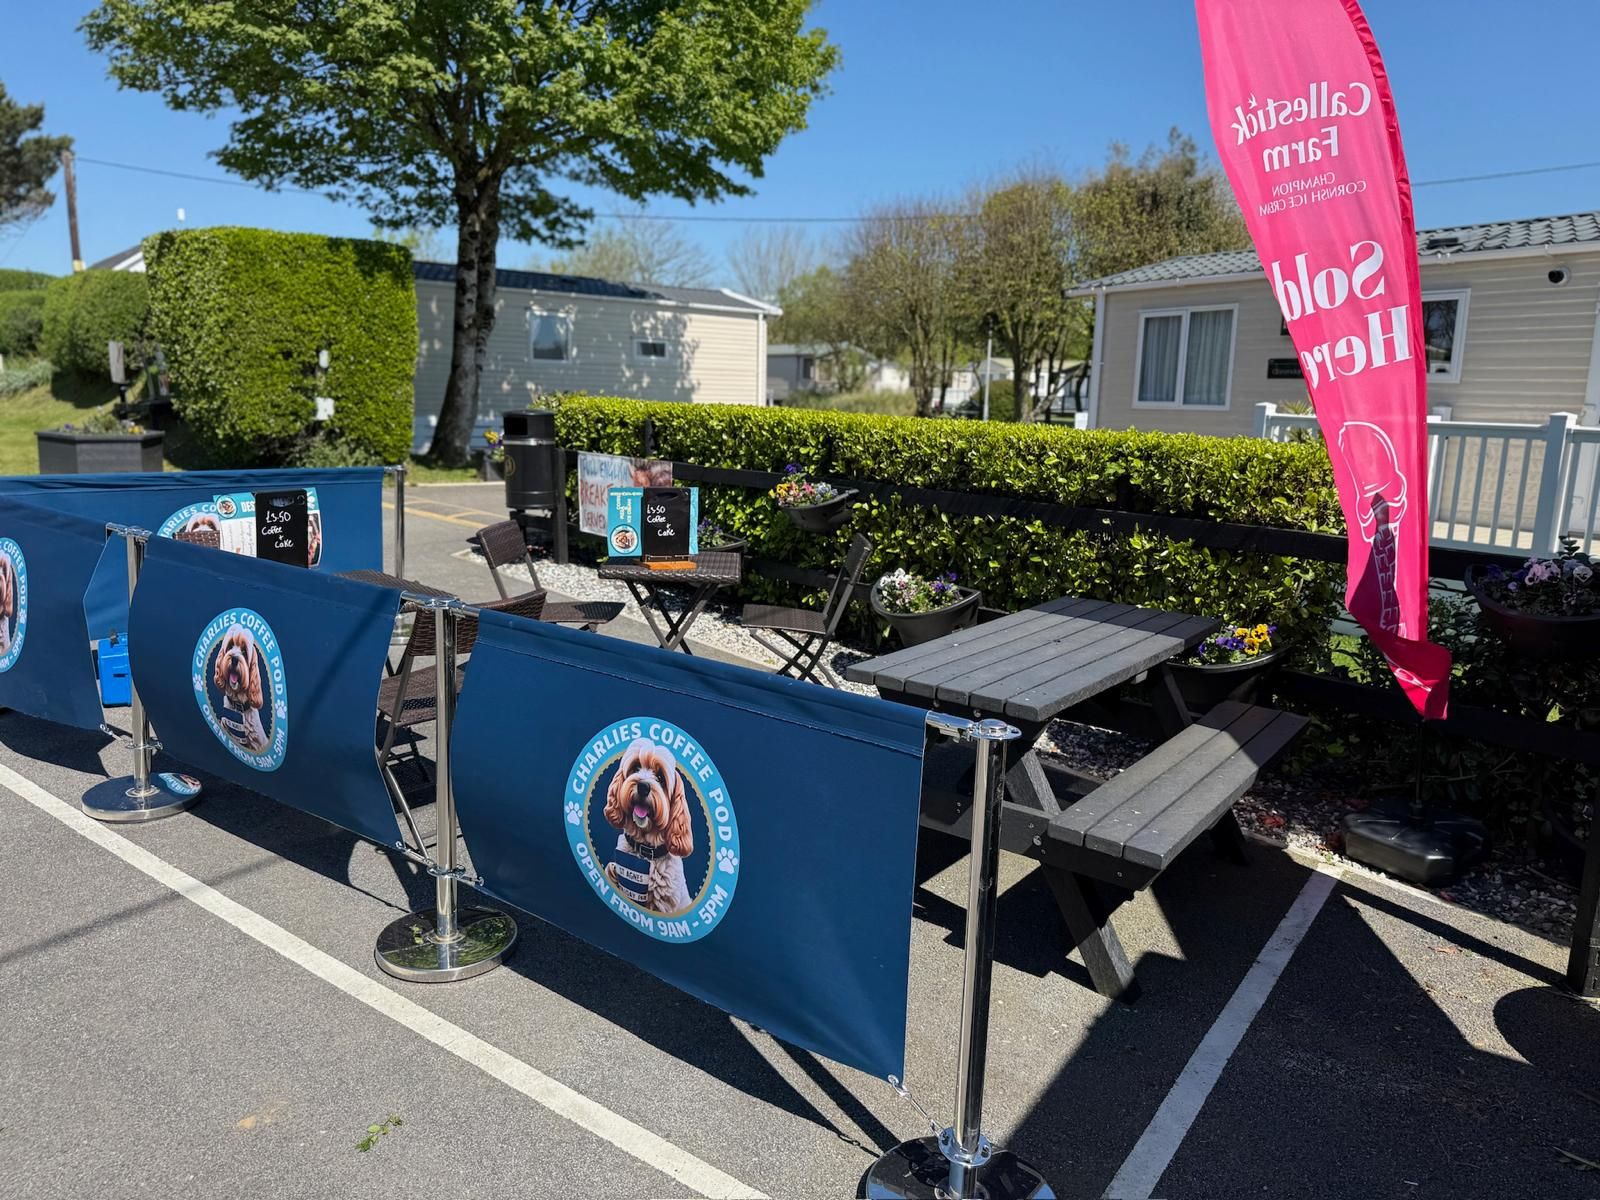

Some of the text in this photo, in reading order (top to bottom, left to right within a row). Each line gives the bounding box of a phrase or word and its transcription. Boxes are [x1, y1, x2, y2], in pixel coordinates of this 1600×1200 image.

[161, 505, 197, 538] ARLIES
[580, 480, 612, 507] BREAK
[3, 541, 24, 572] COFFEE
[196, 612, 284, 695] CHARLIES COFFEE POD
[202, 703, 227, 744] OPEN
[228, 738, 257, 767] FROM
[256, 755, 276, 769] 9AM
[274, 727, 285, 756] 5PM
[572, 722, 732, 842] CHARLIES COFFEE POD
[576, 842, 610, 895] OPEN
[609, 894, 654, 933] FROM
[657, 920, 692, 938] 9AM
[698, 884, 728, 925] 5PM
